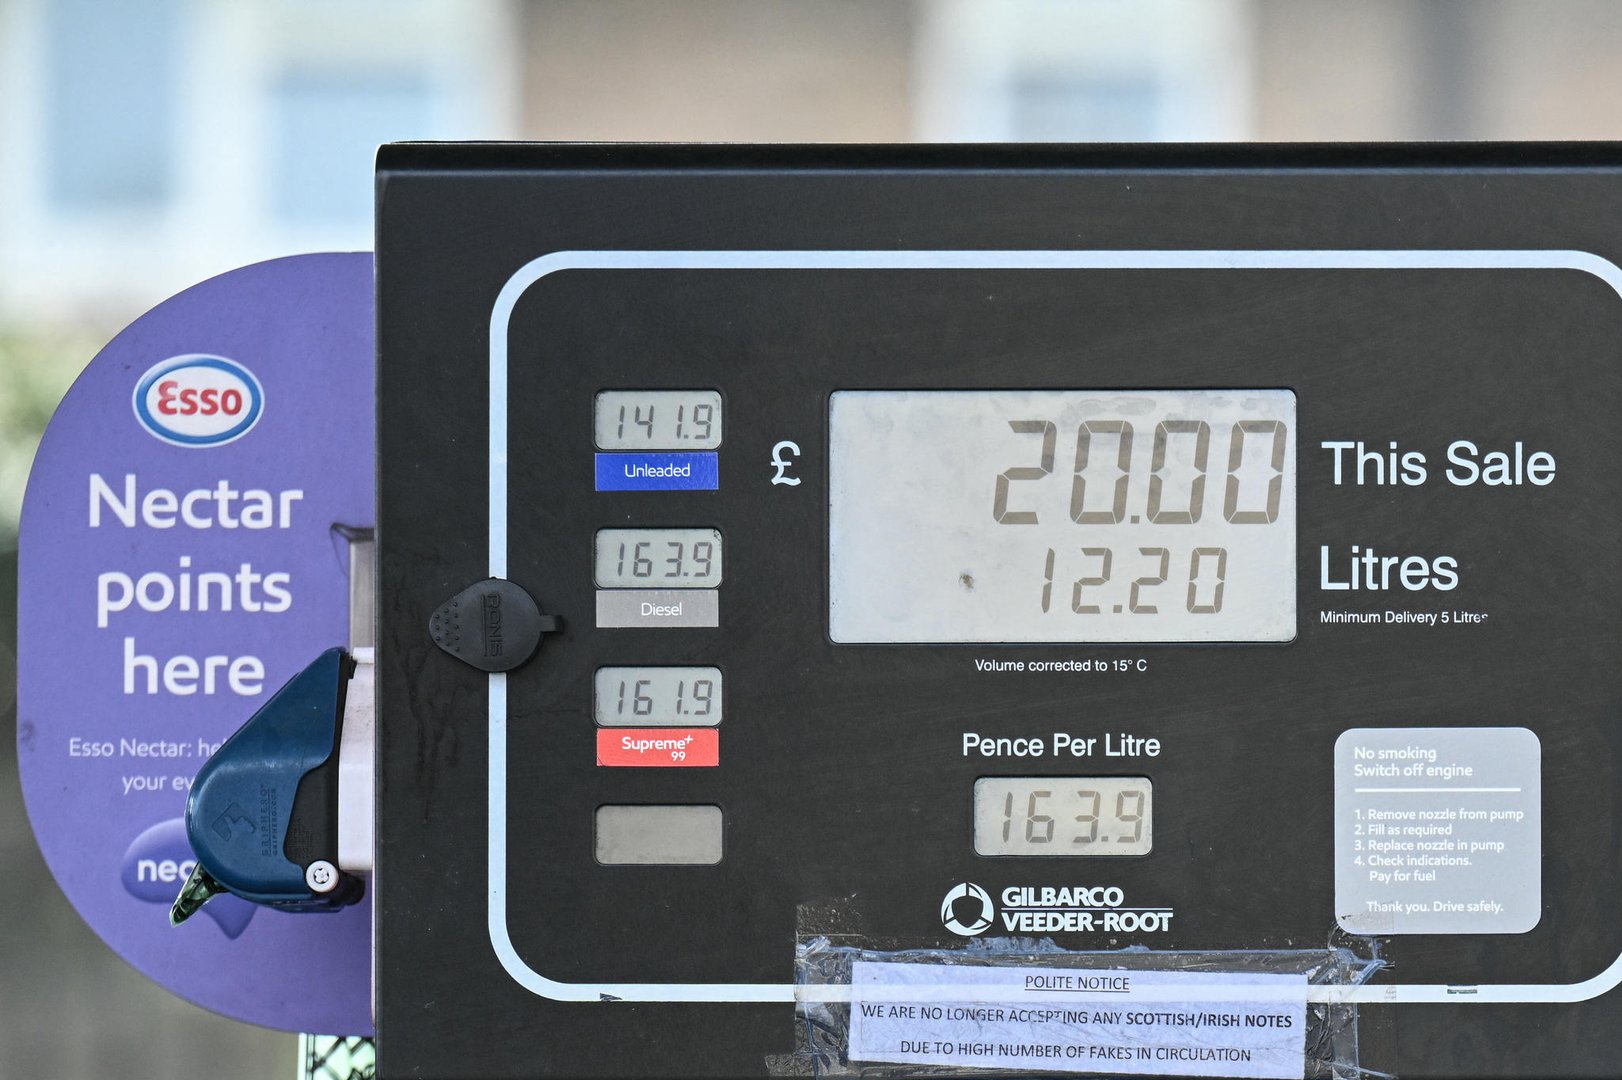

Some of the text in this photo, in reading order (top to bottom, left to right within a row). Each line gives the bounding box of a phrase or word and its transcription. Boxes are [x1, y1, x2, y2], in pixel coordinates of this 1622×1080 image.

[157, 380, 242, 418] Esso
[617, 403, 714, 440] 141.9
[624, 463, 691, 478] Unleaded
[770, 440, 801, 487] £
[993, 420, 1288, 525] 20.00
[1321, 440, 1556, 487] This Sale
[88, 473, 303, 530] Nectar
[617, 541, 714, 578] 163.9
[1320, 546, 1459, 591] Litres
[1041, 547, 1228, 614] 12.20
[97, 556, 293, 627] points
[640, 602, 682, 617] Diesel
[1320, 611, 1381, 624] Minimum
[1385, 611, 1438, 627] Delivery
[1441, 611, 1450, 624] 5
[123, 638, 266, 697] here
[975, 659, 1025, 671] Volume
[1028, 659, 1091, 671] corrected
[1094, 660, 1108, 671] to
[1136, 659, 1147, 671] C
[617, 679, 714, 716] 161.9
[69, 737, 114, 757] Esso
[120, 738, 193, 757] Nectar:
[962, 732, 1161, 757] Pence Per Litre
[1354, 746, 1437, 762] No smoking
[671, 751, 686, 762] 99
[1354, 762, 1473, 780] Switch off engine
[122, 776, 167, 795] your
[1001, 790, 1145, 843] 163.9
[1354, 809, 1524, 824] 1. Remove nozzle from pump
[1354, 824, 1452, 837] 2. Fill as required
[1354, 840, 1504, 855] 3. Replace nozzle in pump
[1354, 855, 1472, 866] 4. Check indications.
[1369, 870, 1436, 884] Pay for fuel
[1002, 887, 1124, 907] GILBARCO
[1366, 901, 1503, 916] Thank you. Drive safely.
[1002, 912, 1173, 932] VEEDER-ROOT
[1025, 975, 1130, 990] POLITE NOTICE
[861, 1005, 1292, 1028] WE ARE NO LONGER ACCEPTING ANY SCOTTISH/IRISH NOTES
[900, 1041, 1251, 1062] DUE TO HIGH NUMBER OF FAKES IN CIRCULATION
